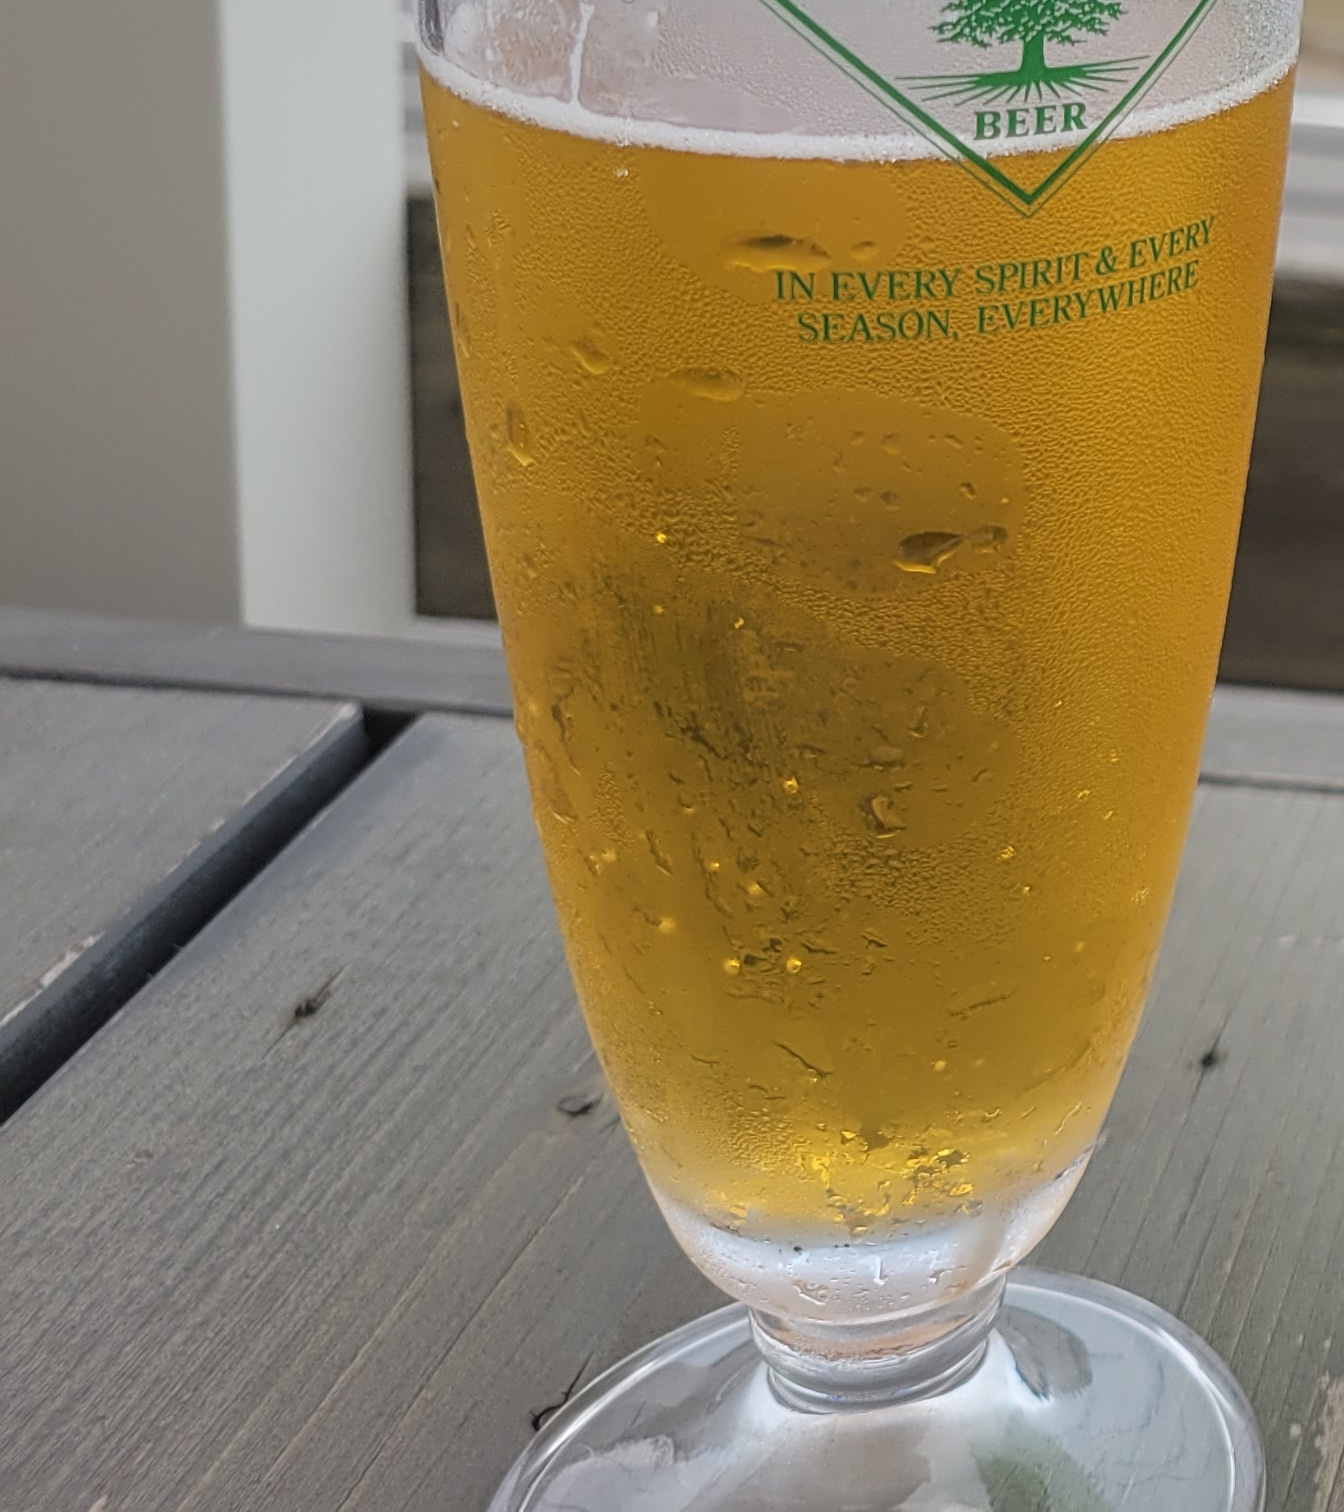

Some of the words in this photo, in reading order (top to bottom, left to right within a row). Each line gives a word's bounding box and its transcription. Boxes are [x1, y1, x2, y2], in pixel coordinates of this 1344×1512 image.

[972, 101, 1088, 141] BEER
[775, 270, 815, 301] IN
[829, 267, 962, 301] EVERY
[974, 251, 1089, 298] SPIRIT
[1094, 246, 1118, 275] &
[1128, 216, 1215, 269] EVERY
[798, 308, 959, 343] SEASON,
[977, 259, 1199, 335] EVERYWHERE
